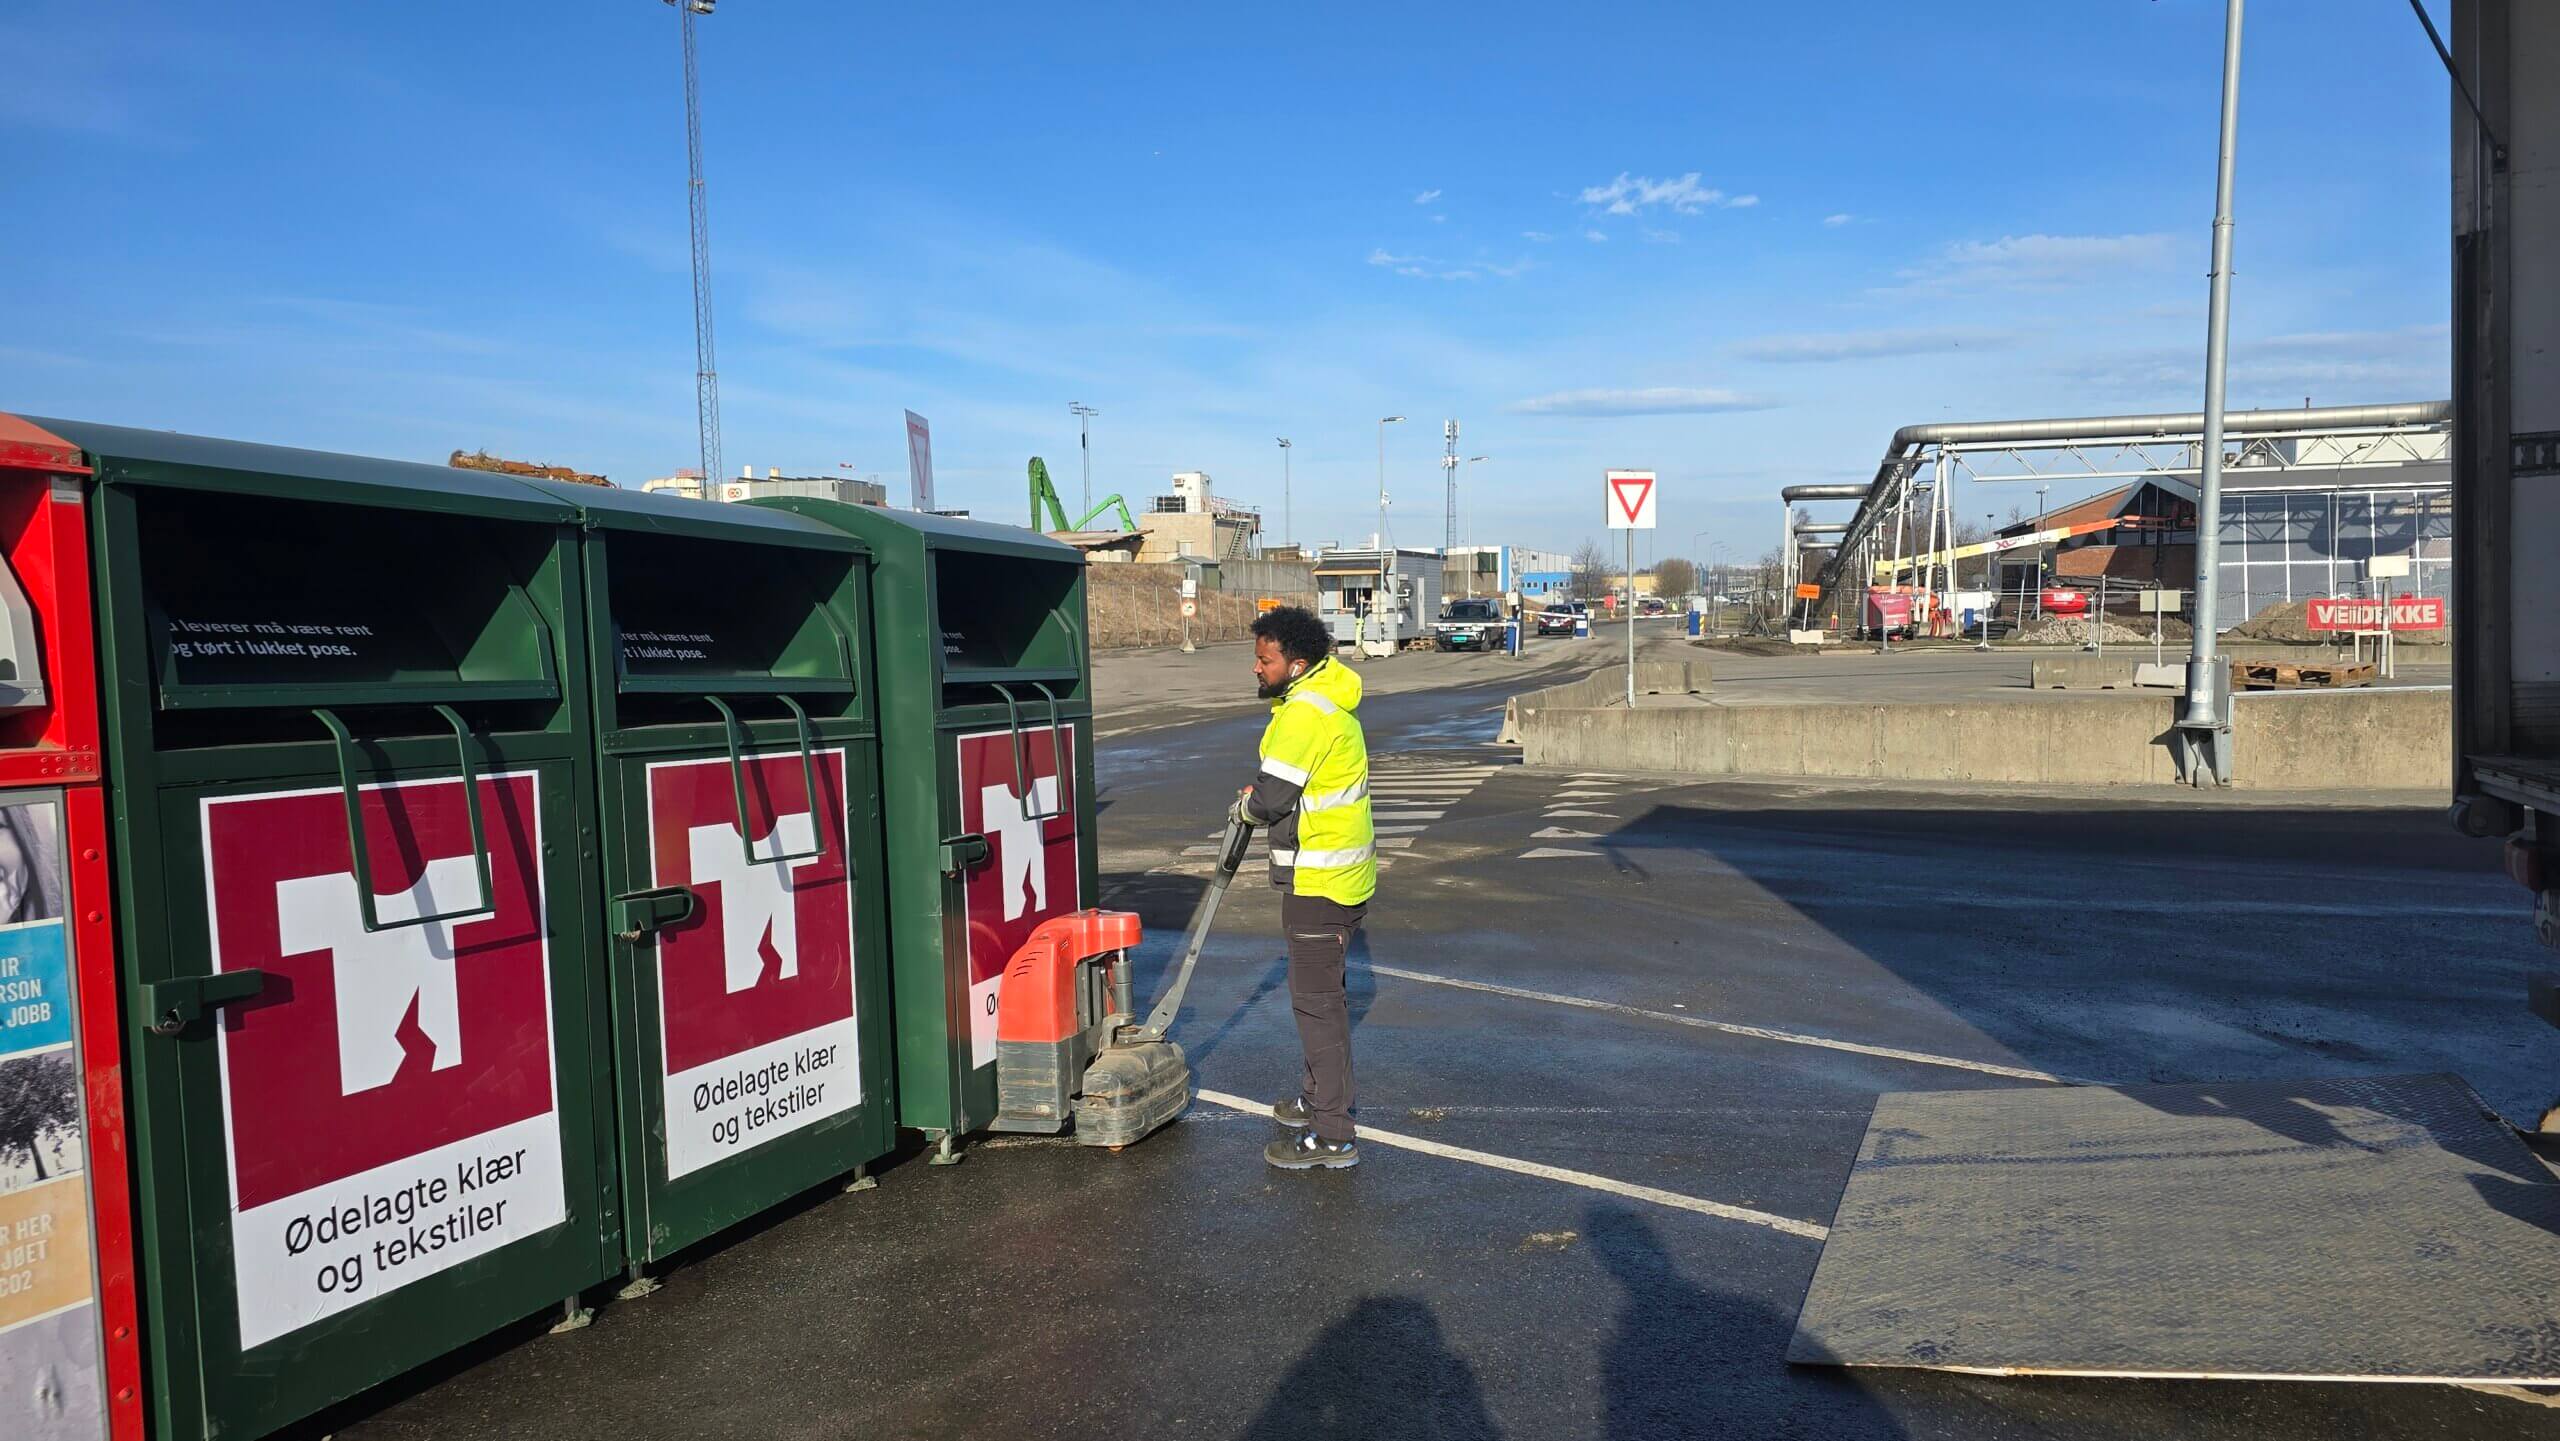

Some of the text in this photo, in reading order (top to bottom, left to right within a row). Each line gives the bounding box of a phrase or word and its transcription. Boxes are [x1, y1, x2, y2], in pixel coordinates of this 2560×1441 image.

[179, 619, 250, 633] leverer
[253, 621, 286, 634] må
[286, 624, 333, 635] være
[335, 624, 374, 636] rent
[640, 631, 660, 641] må
[660, 633, 690, 641] være
[689, 633, 714, 642] rent
[194, 640, 235, 655] tørt
[235, 640, 245, 655] i
[247, 640, 304, 656] lukket
[308, 643, 358, 659] pose.
[638, 646, 676, 658] lukket
[676, 649, 707, 661] pose.
[6, 1002, 51, 1028] JOBB
[693, 1044, 837, 1113] Ødelagte klær
[712, 1082, 825, 1145] og tekstiler
[285, 1148, 526, 1257] Ødelagte klær
[16, 1214, 53, 1240] HER
[317, 1199, 507, 1294] og tekstiler
